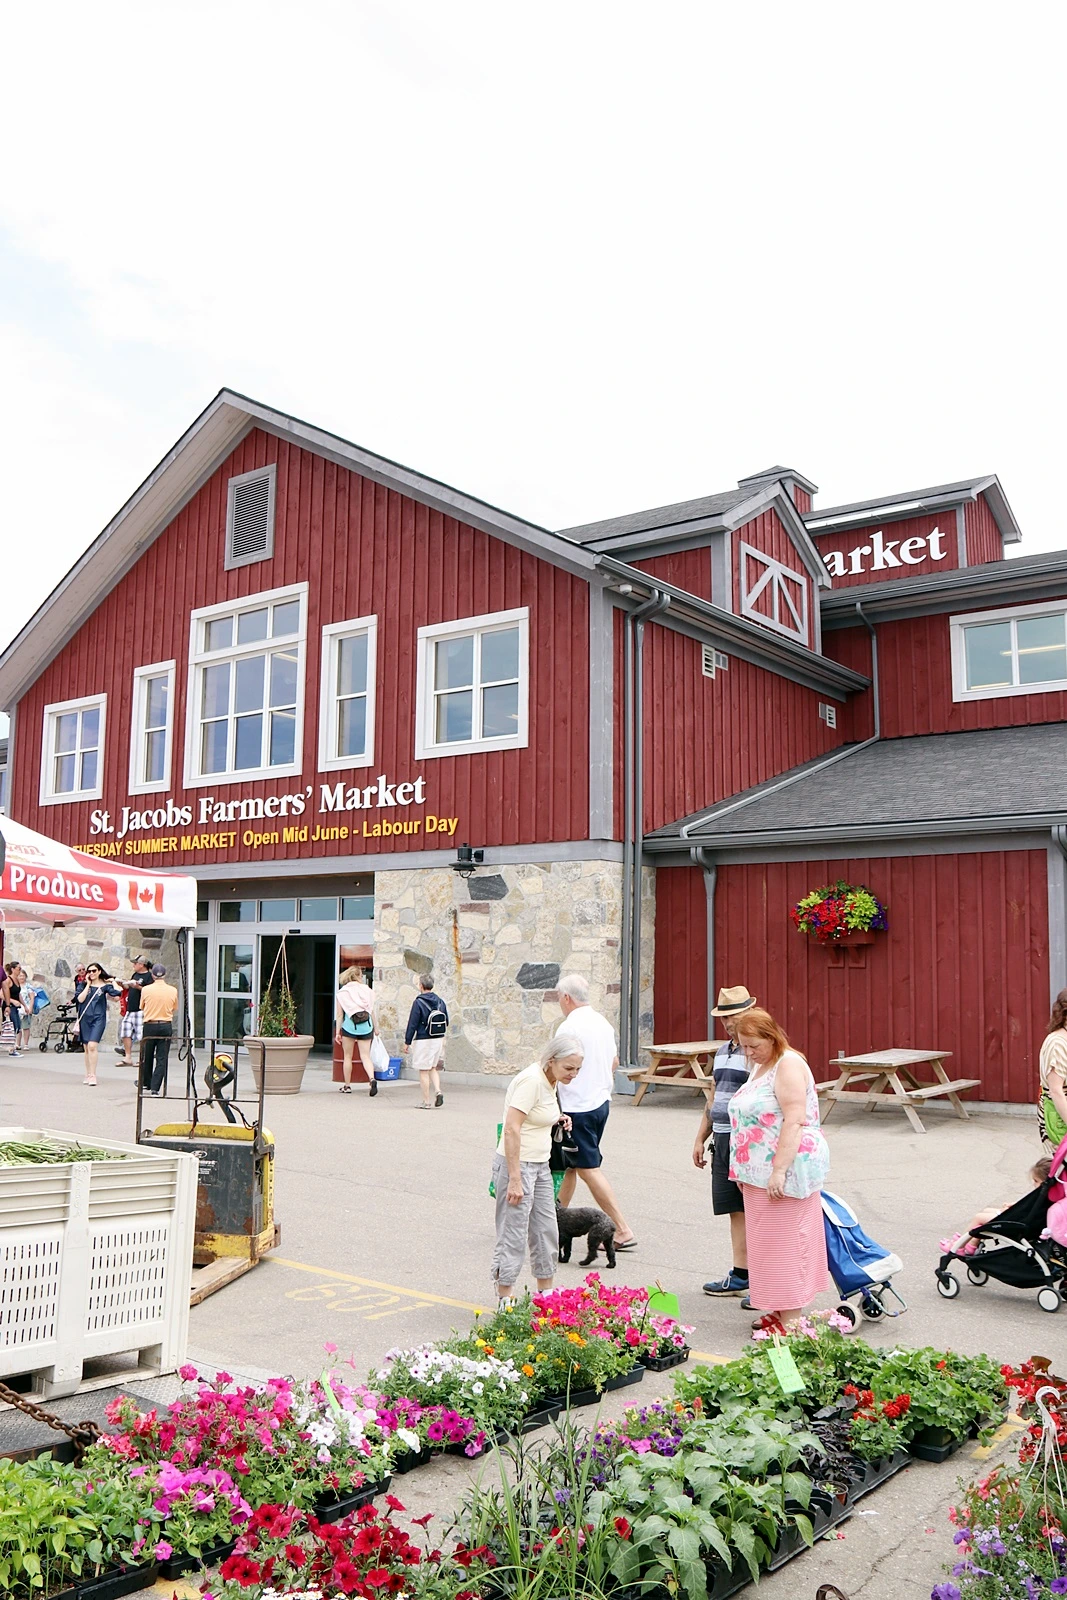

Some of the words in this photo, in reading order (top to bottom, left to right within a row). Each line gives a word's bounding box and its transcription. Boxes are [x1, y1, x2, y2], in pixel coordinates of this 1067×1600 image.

[821, 526, 947, 577] arket
[90, 809, 115, 835] St.
[117, 798, 193, 839] Jacobs
[318, 774, 427, 813] Market
[125, 836, 178, 855] SUMMER
[180, 831, 237, 851] MARKET
[242, 829, 280, 849] Open
[282, 825, 309, 844] Mid
[311, 824, 349, 842] June
[362, 818, 422, 838] Labour
[425, 815, 459, 835] Day
[10, 864, 105, 903] Produce
